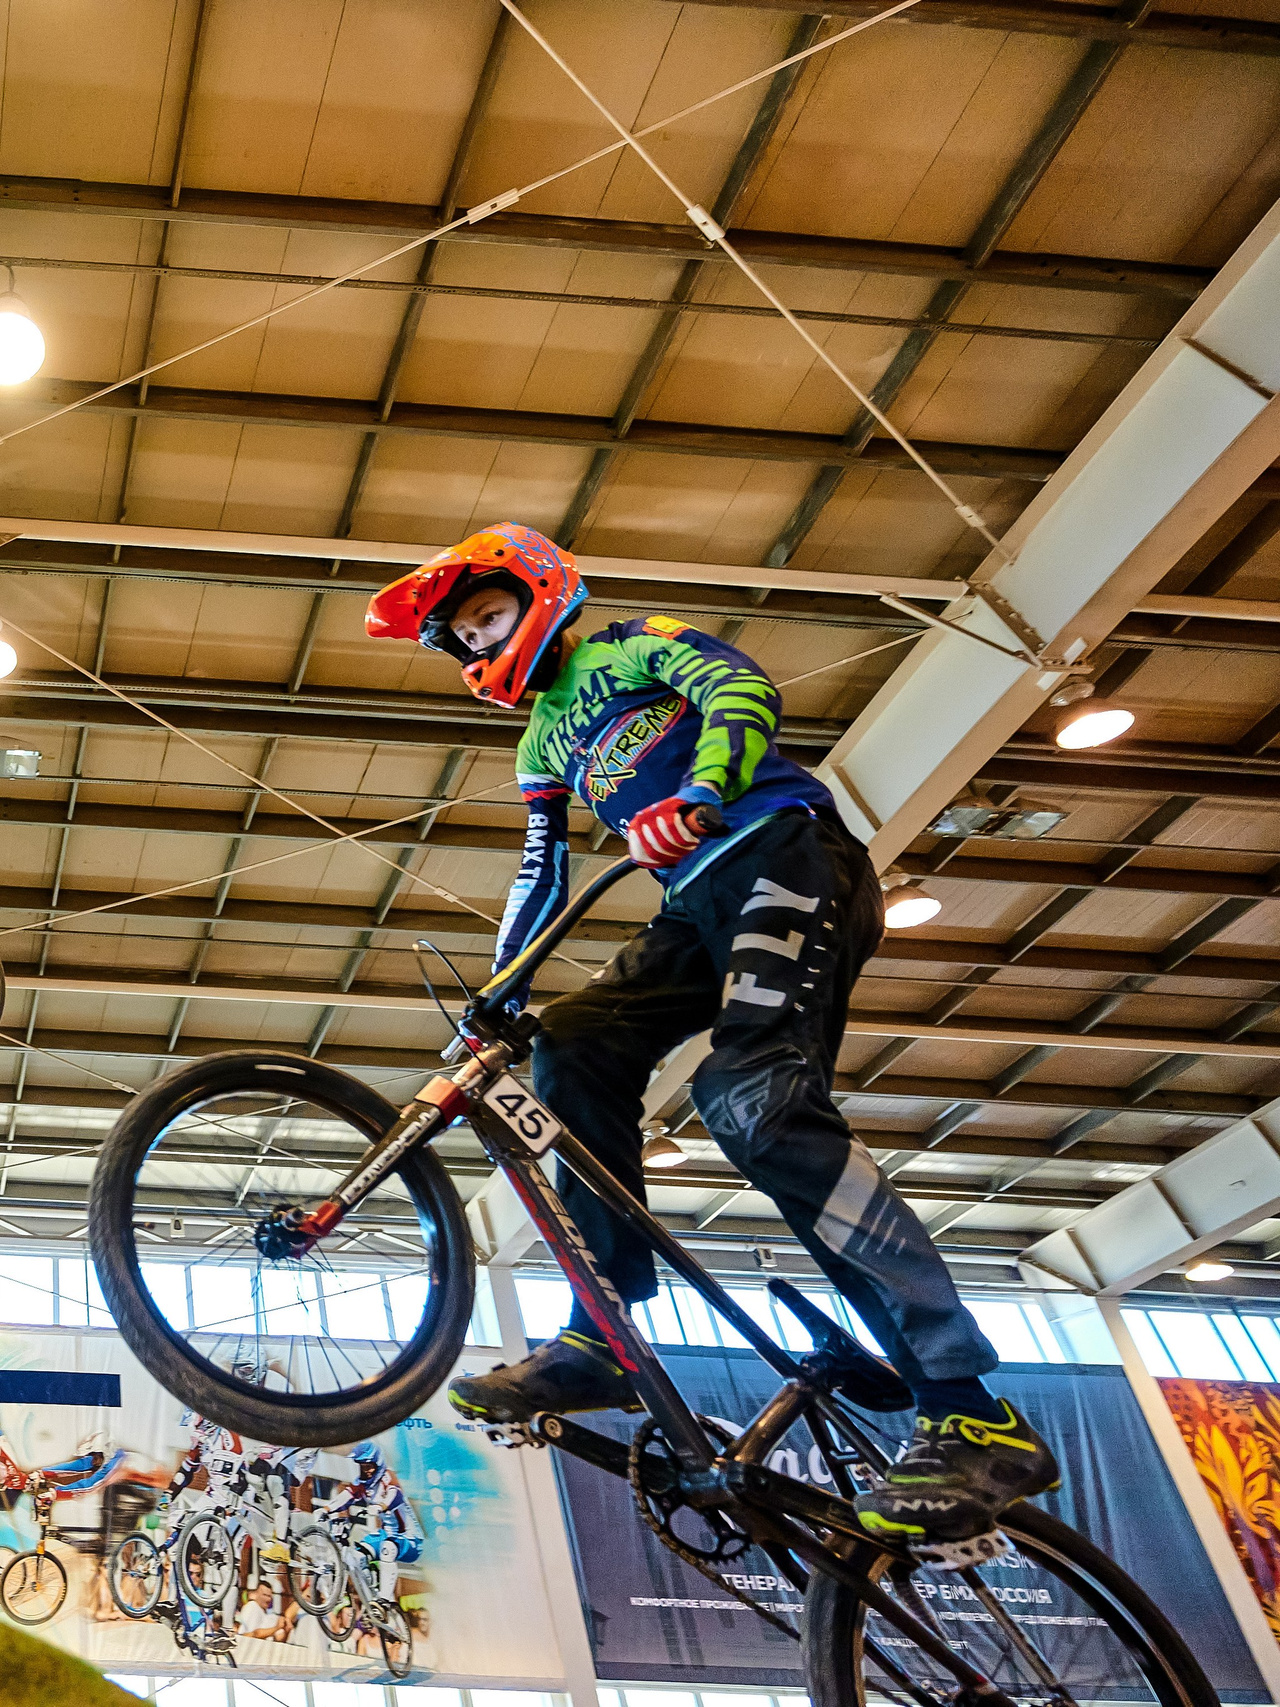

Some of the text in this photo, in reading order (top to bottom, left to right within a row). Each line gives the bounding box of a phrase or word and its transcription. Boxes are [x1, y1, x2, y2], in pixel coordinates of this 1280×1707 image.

[589, 698, 681, 801] EXTREME
[521, 813, 549, 865] BMX
[722, 877, 820, 1009] FLY
[496, 1093, 552, 1140] 45
[991, 1586, 1053, 1604] ОССИЯ
